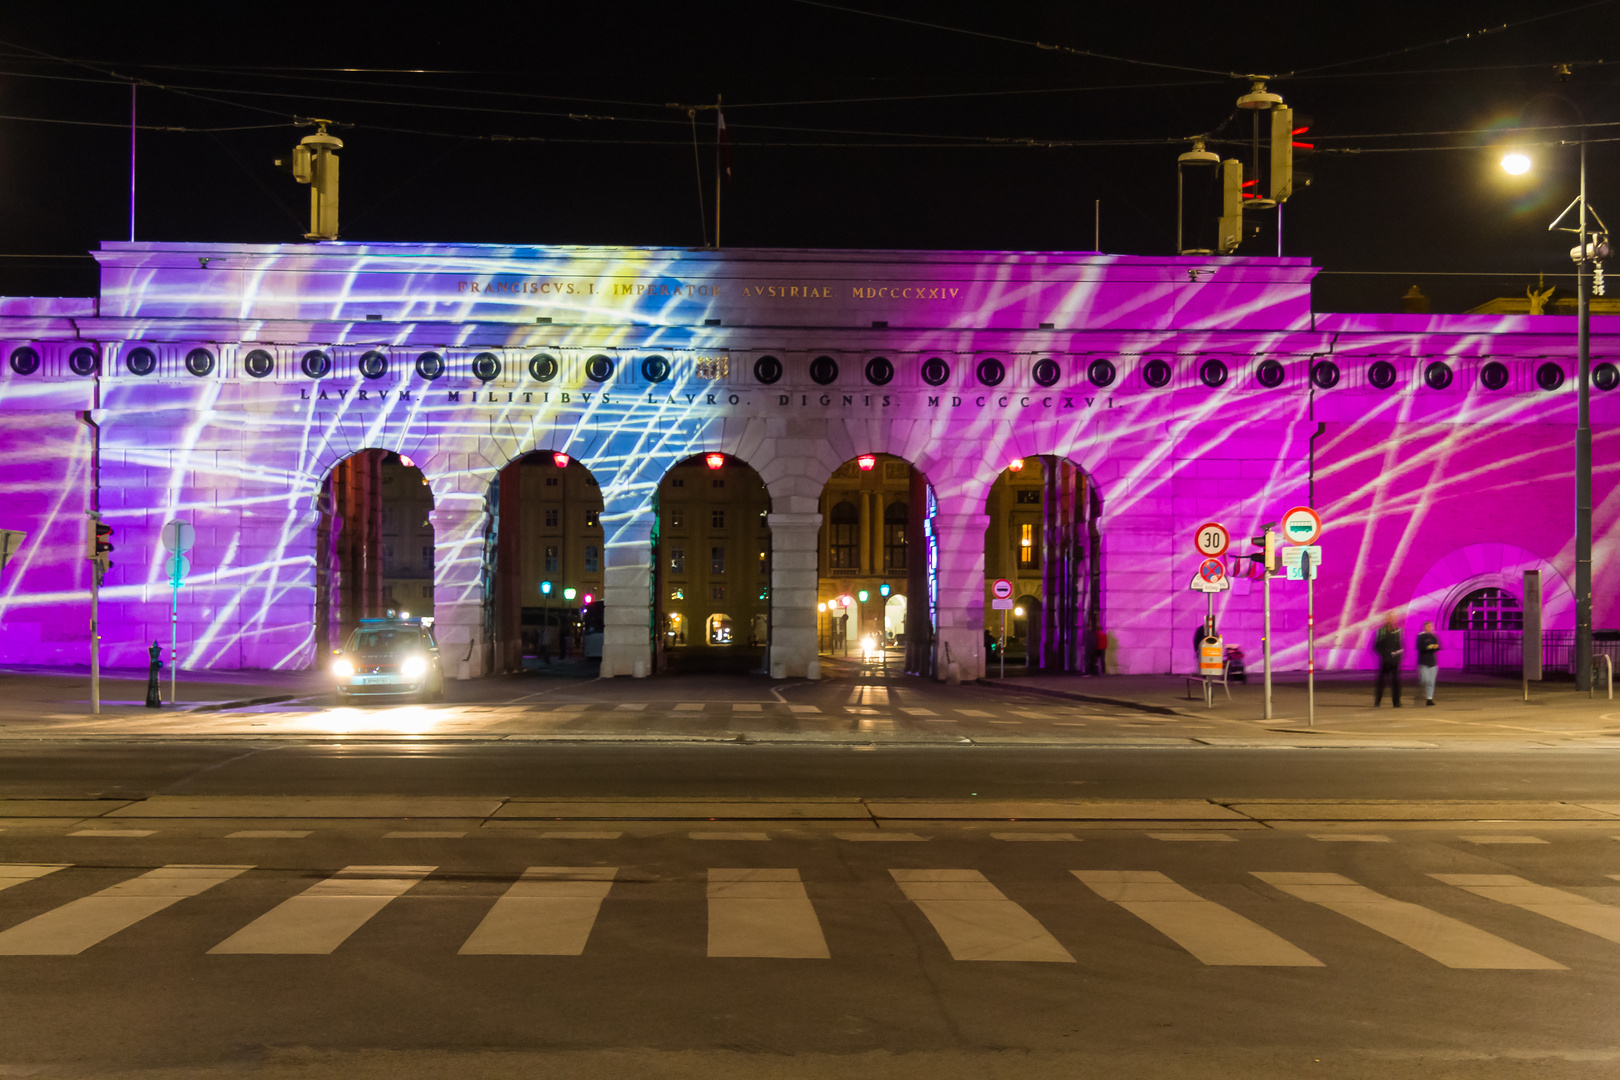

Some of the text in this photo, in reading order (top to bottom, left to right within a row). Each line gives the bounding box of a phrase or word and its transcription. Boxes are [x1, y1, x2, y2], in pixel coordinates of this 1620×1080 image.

[457, 281, 581, 295] FRANCISCVS.
[300, 388, 1123, 409] LAVRVM. MILITIBVS. LAVRO. DIGNIS. MDCCCCXVI.
[1204, 532, 1220, 548] 30
